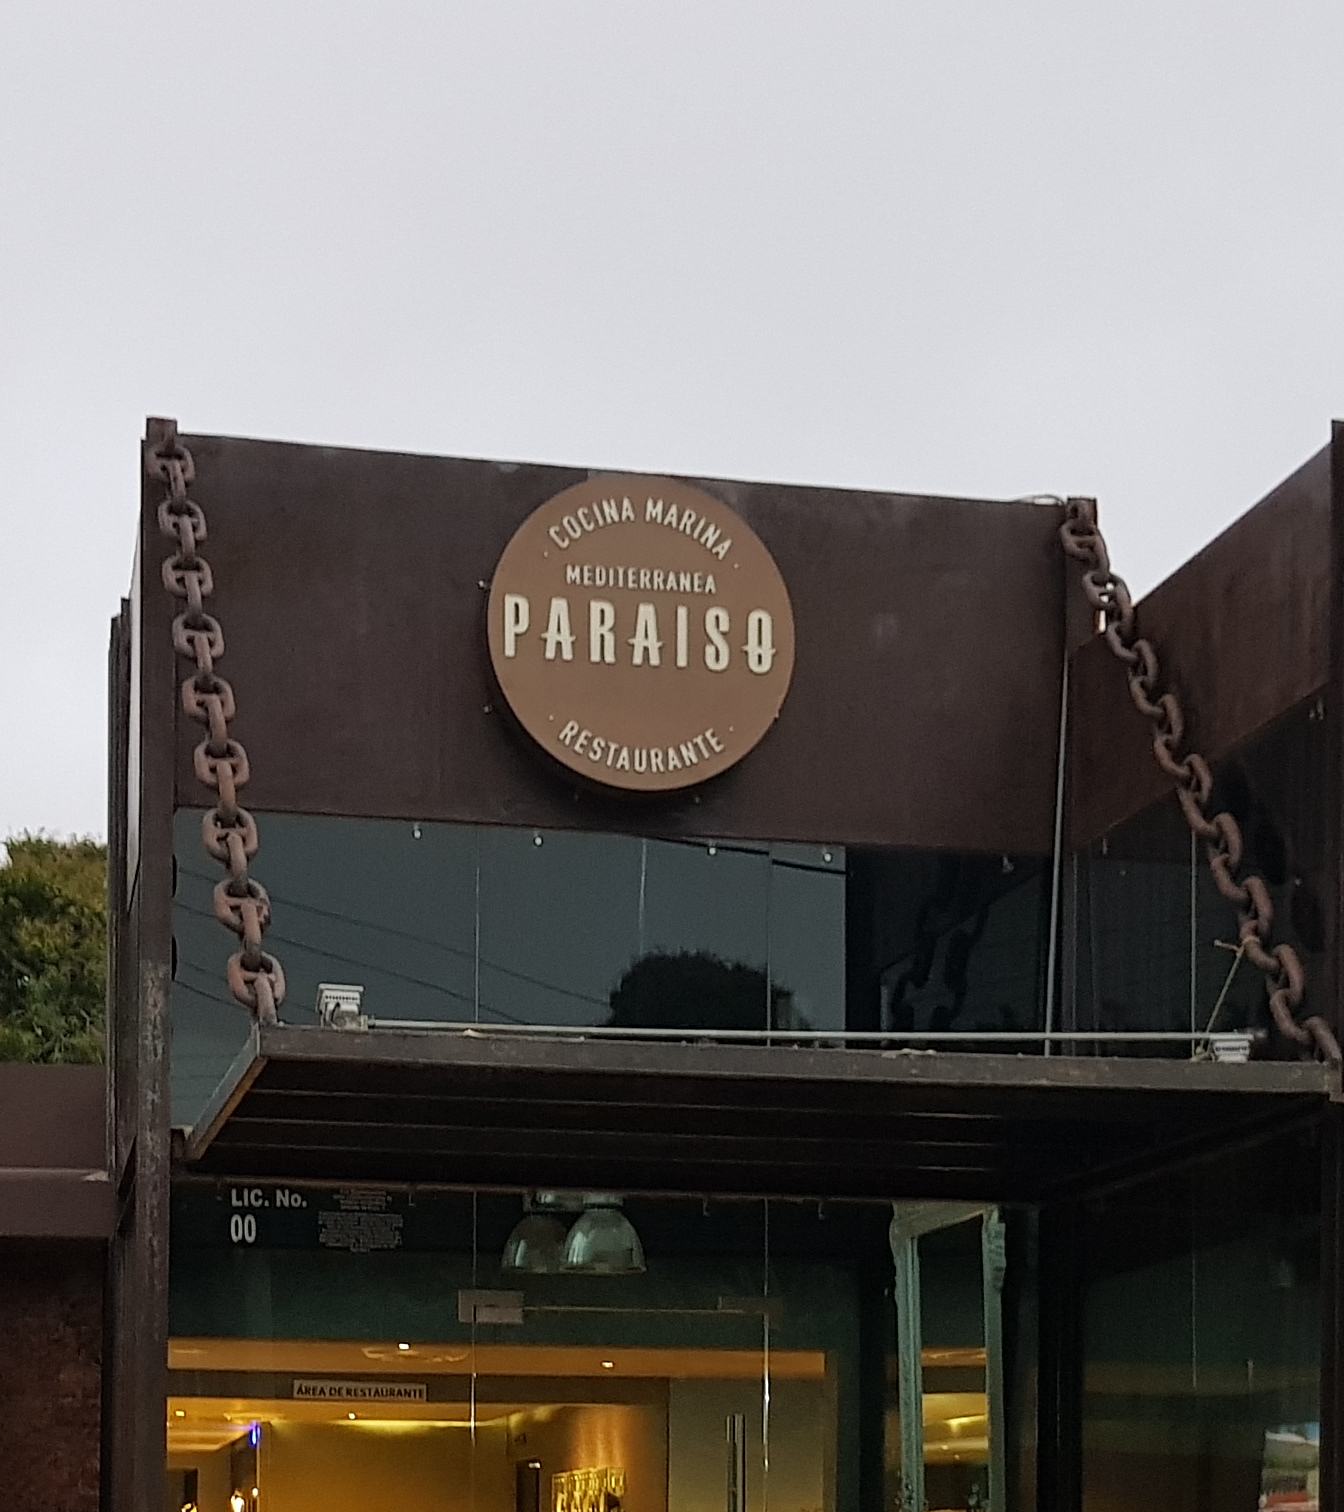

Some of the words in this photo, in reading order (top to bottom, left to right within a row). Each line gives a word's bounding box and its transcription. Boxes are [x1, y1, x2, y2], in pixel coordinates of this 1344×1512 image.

[549, 497, 635, 549] COCINA
[645, 498, 733, 561] MARINA
[566, 565, 717, 594] MEDITERRANEA
[504, 594, 777, 674] PARAISO
[559, 720, 725, 773] RESTAURANTE
[231, 1188, 269, 1208] LIC.
[275, 1189, 307, 1208] No.
[230, 1213, 256, 1243] 00
[329, 1386, 344, 1397] DE
[346, 1387, 424, 1399] RESTAURANTE
